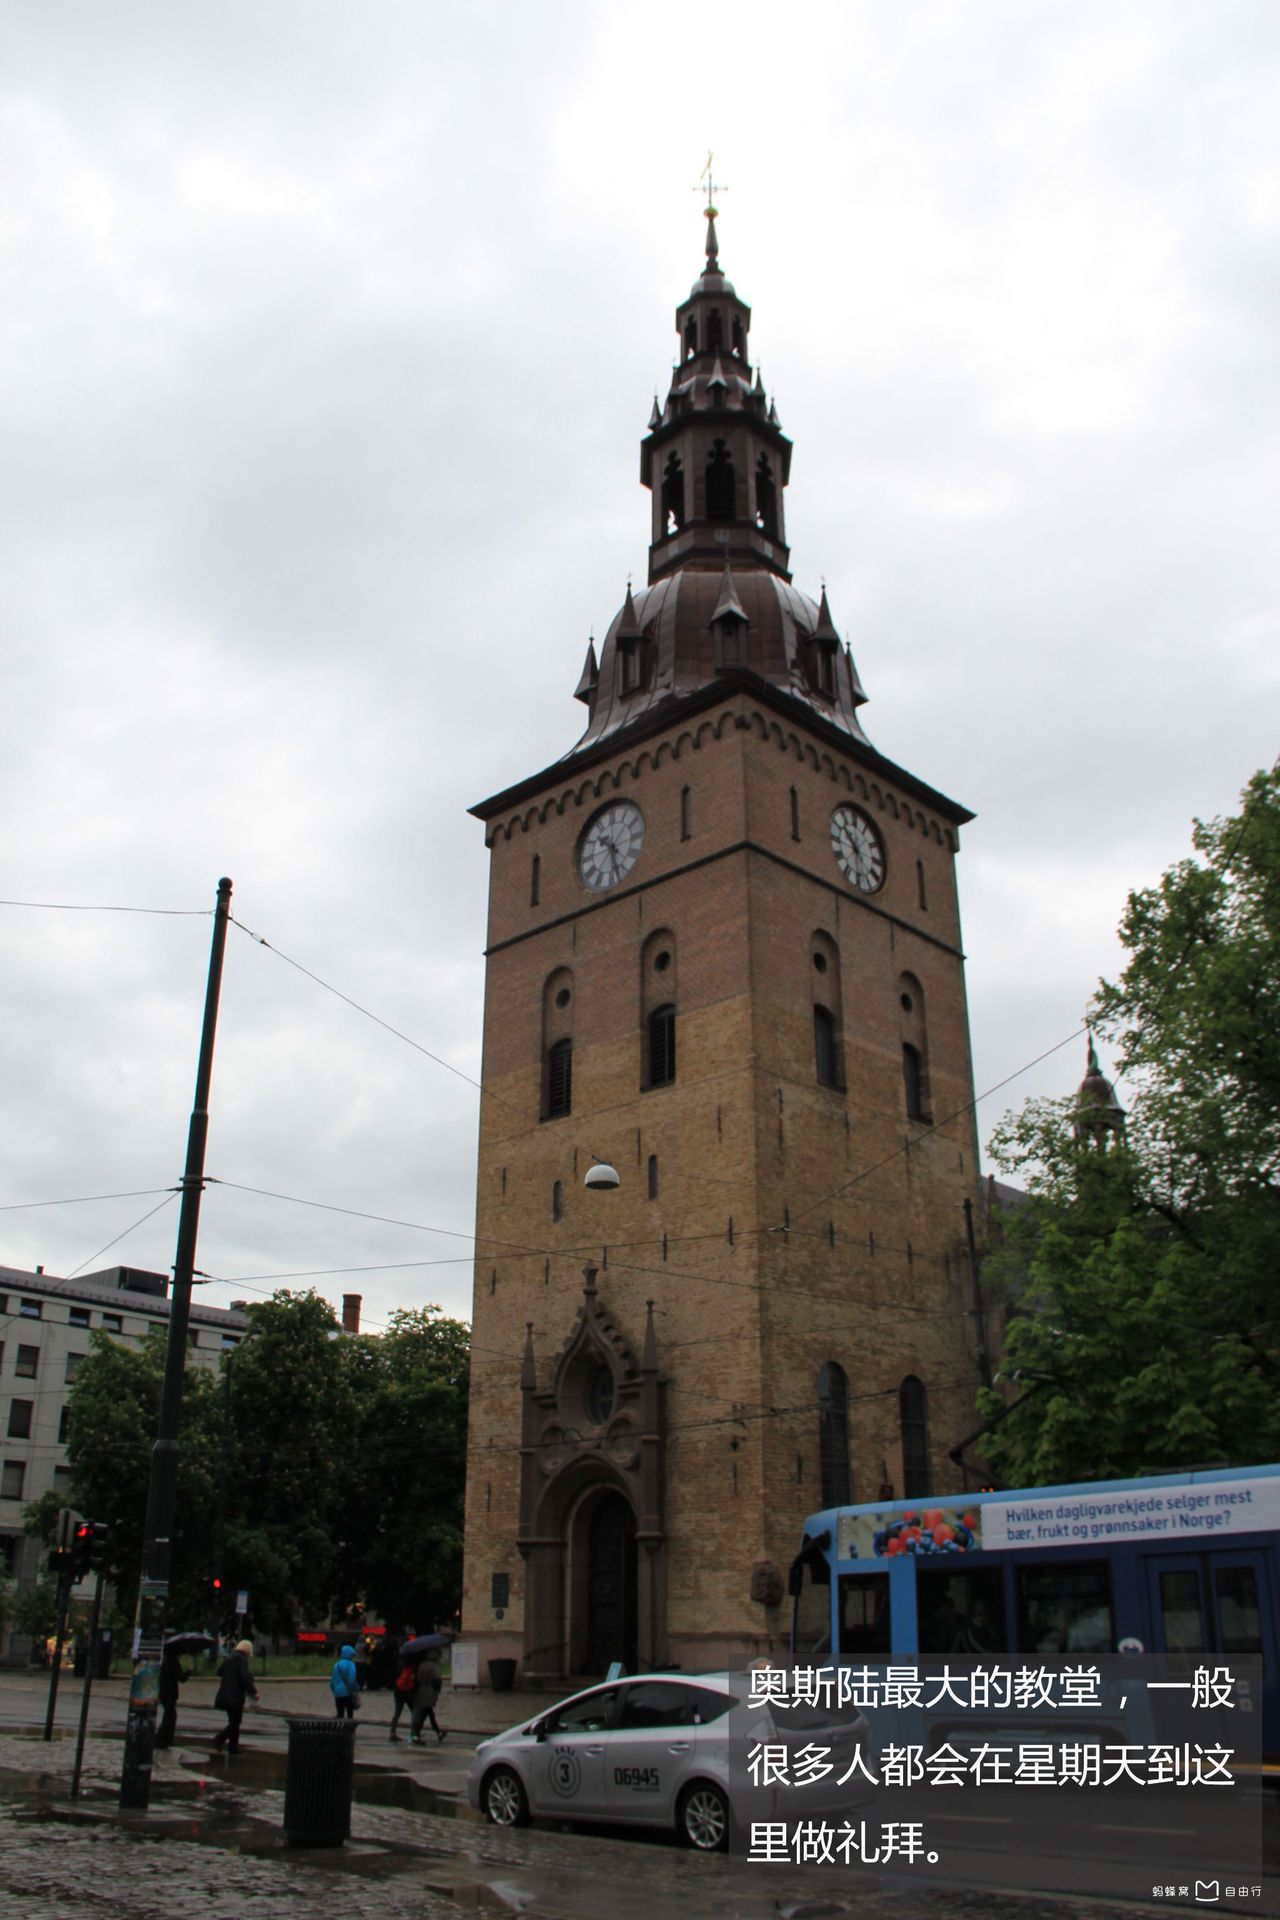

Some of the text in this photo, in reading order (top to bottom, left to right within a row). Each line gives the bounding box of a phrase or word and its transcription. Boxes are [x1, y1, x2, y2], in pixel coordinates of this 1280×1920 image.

[1006, 1489, 1252, 1522] Hvilken dagligvarekjede selger mest
[1007, 1527, 1035, 1541] bær,
[1037, 1523, 1069, 1538] frukt
[1072, 1524, 1088, 1538] og
[1091, 1516, 1168, 1537] grønnsaker
[1179, 1510, 1231, 1529] Norge?
[555, 1745, 576, 1757] TAXI
[560, 1763, 569, 1783] 3
[614, 1767, 660, 1786] 06945
